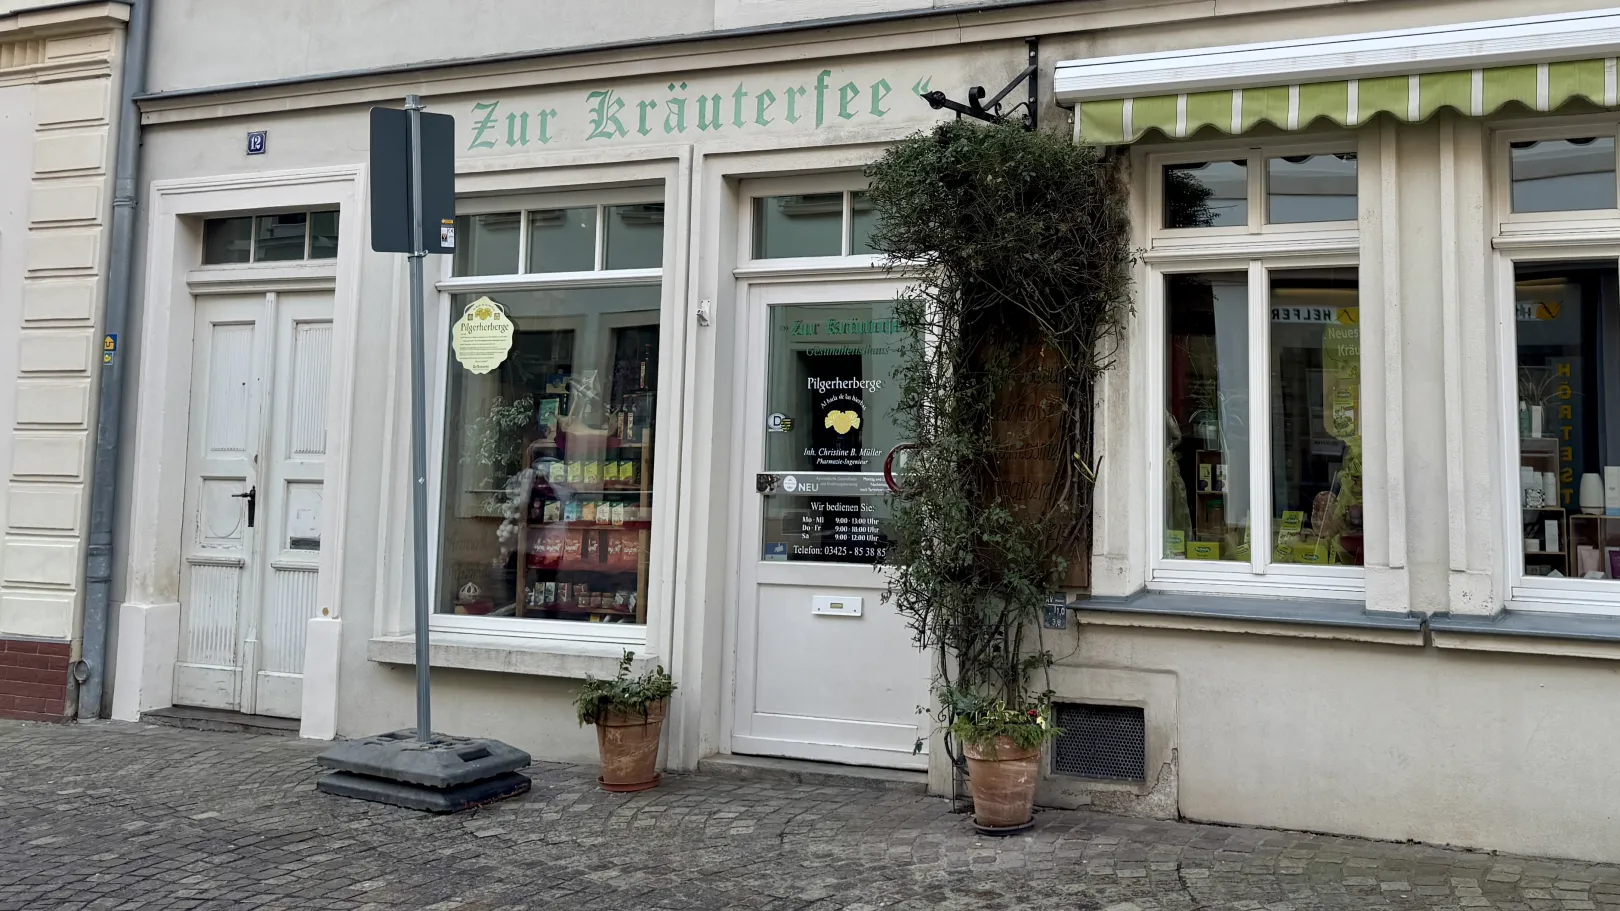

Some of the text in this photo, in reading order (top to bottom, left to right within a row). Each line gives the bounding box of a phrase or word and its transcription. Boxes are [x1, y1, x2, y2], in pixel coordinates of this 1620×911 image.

[467, 101, 558, 151] Zur
[585, 69, 893, 141] Kräuterfee
[251, 135, 261, 150] 12
[460, 322, 509, 334] Pilgerherberge
[791, 319, 819, 336] Zur
[1328, 327, 1359, 340] Neues
[807, 376, 882, 394] Pilgerherberge
[803, 447, 882, 457] Inh. Christine B. Müller
[816, 458, 868, 466] Pharmazie-Ingenieur
[798, 482, 819, 492] NEU
[811, 502, 875, 512] Wir bedienen Sie:
[793, 545, 823, 555] Telefon:
[824, 546, 847, 556] 03425
[854, 546, 864, 556] 85
[865, 547, 875, 557] 38
[876, 547, 886, 557] 85
